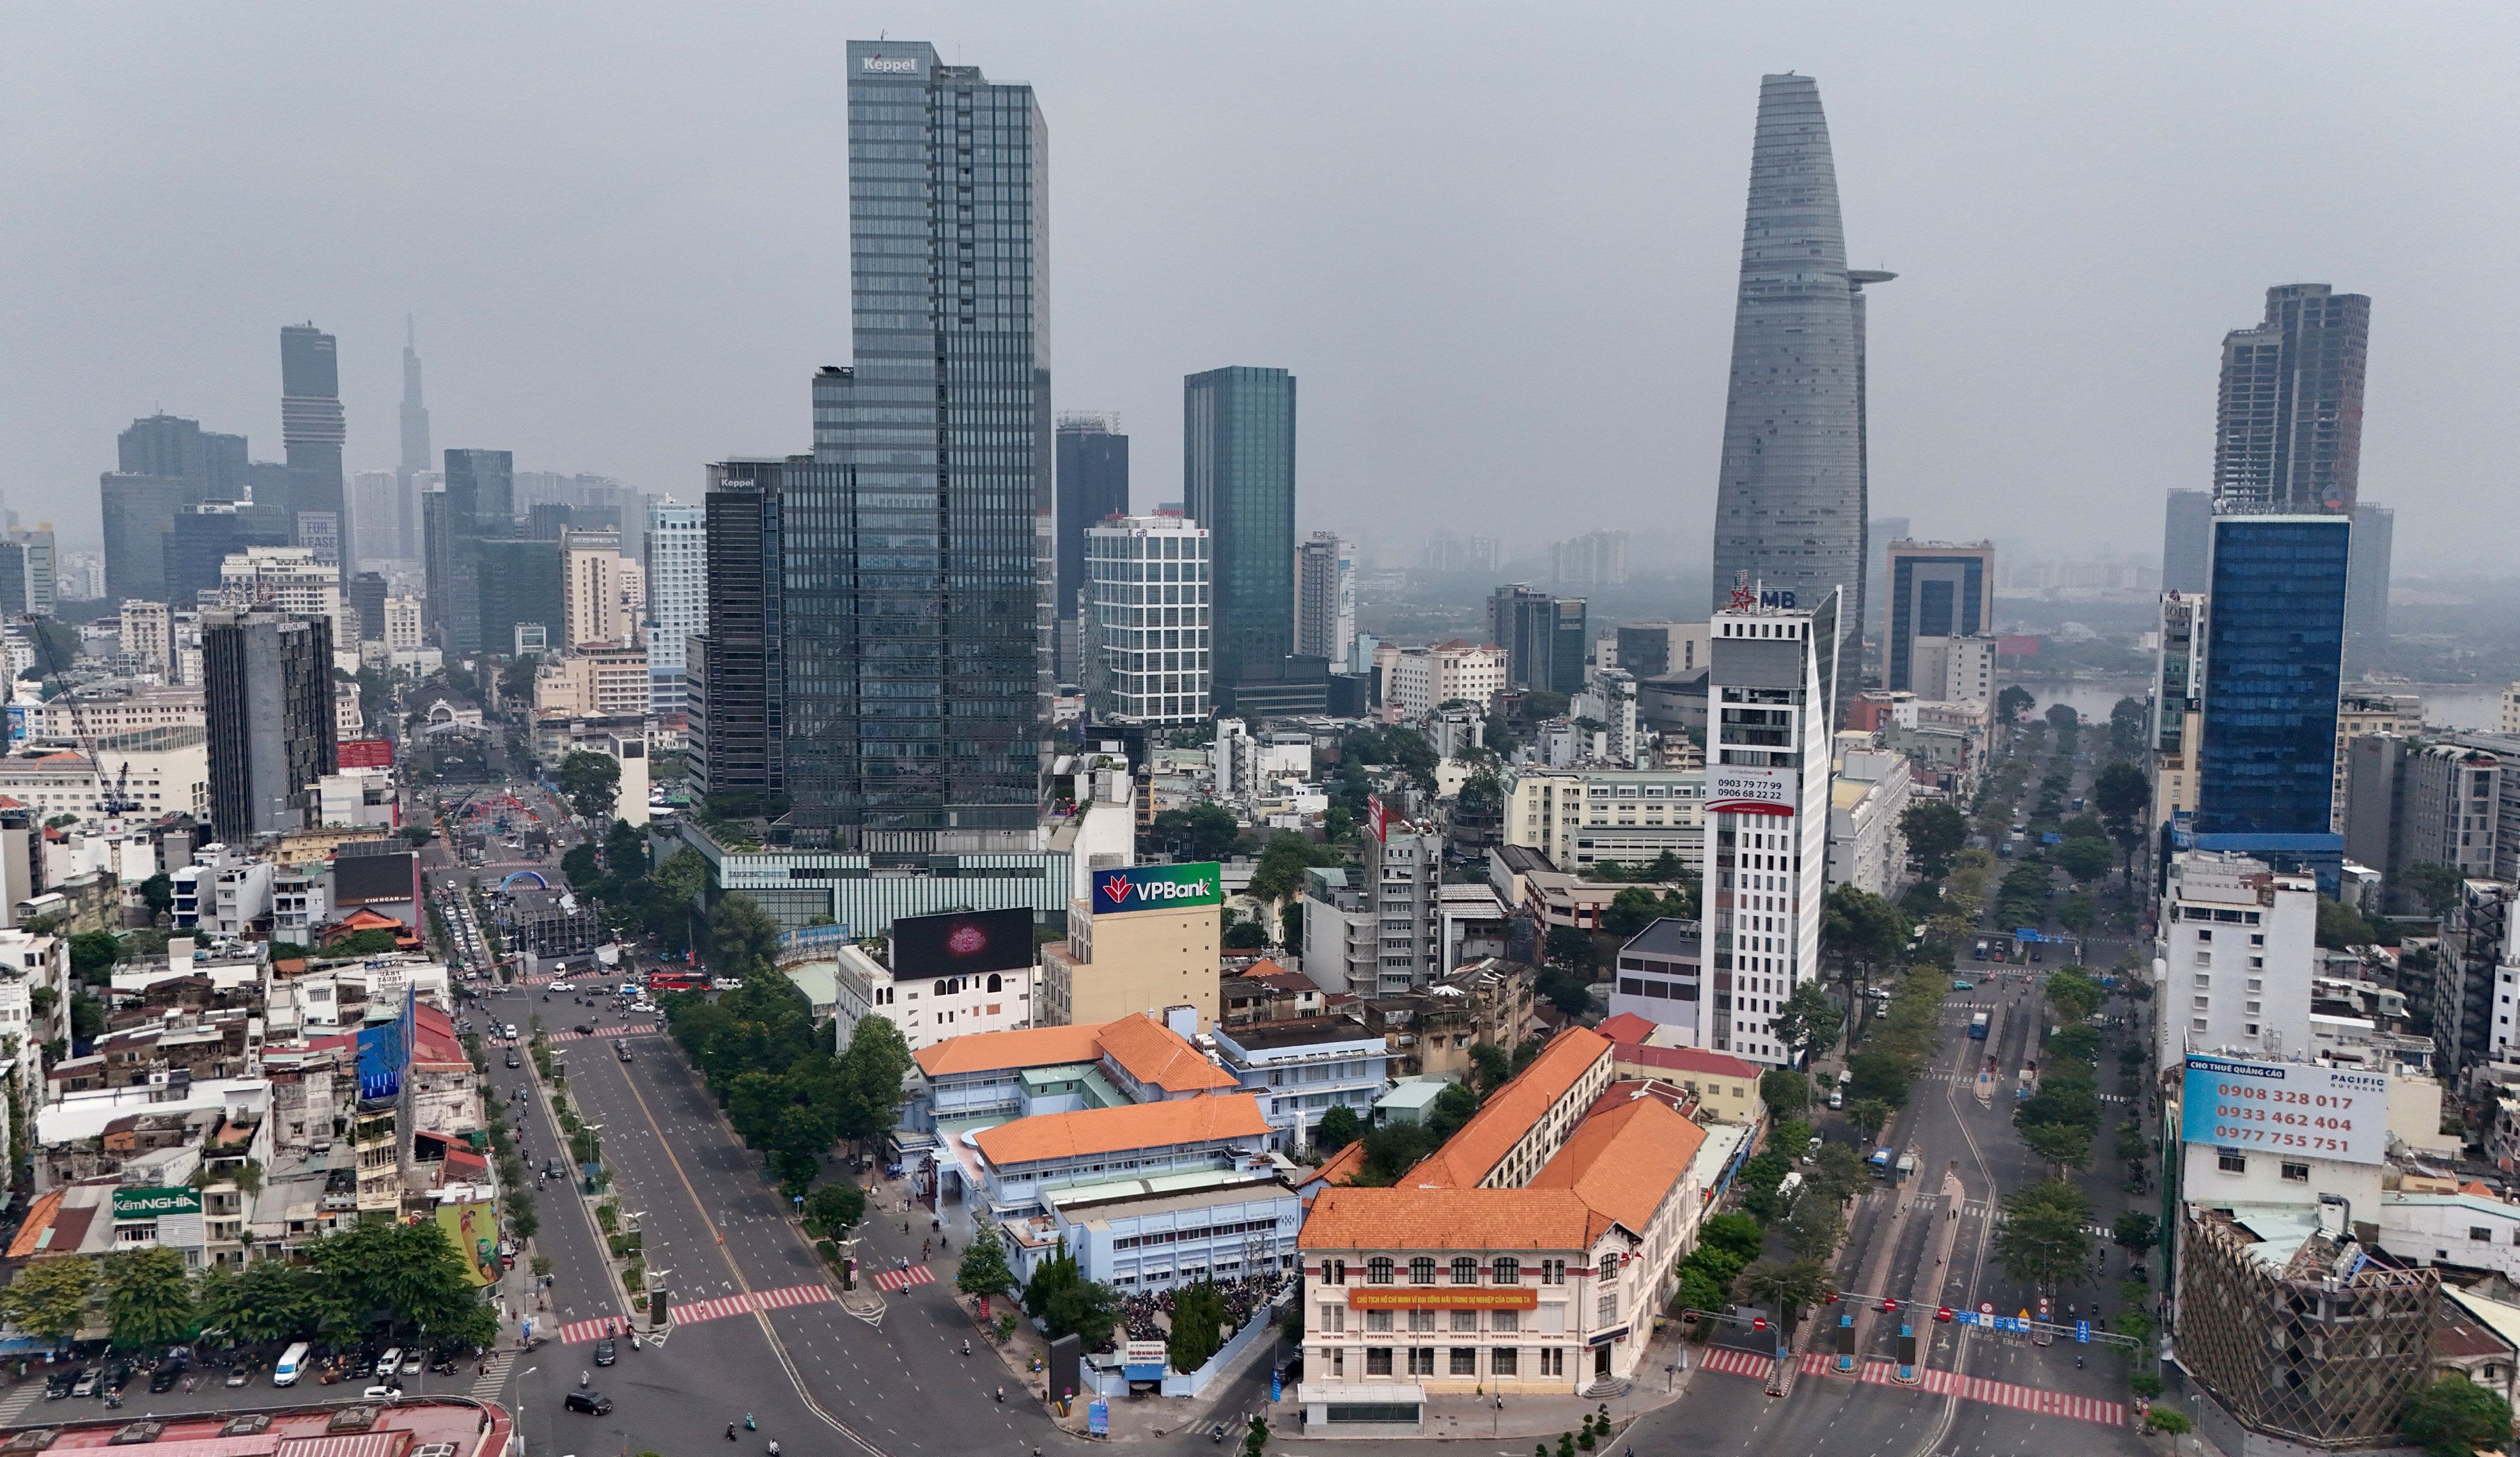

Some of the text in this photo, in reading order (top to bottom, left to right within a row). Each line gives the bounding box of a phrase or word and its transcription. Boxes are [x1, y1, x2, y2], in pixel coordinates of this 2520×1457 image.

[863, 58, 916, 73] Keppel
[721, 479, 754, 487] Keppel
[307, 522, 327, 534] FOR
[1136, 529, 1147, 537] citi
[300, 537, 335, 548] LEASE
[1760, 591, 1796, 609] MB
[277, 621, 310, 633] LIBERTY CENTRAL
[1718, 779, 1740, 787] 0903
[1718, 789, 1740, 797] 0906
[1743, 790, 1754, 798] 68
[1137, 878, 1210, 901] VPBank
[2190, 1061, 2208, 1070] CHO
[2209, 1063, 2231, 1072] THUÊ
[2265, 1067, 2283, 1078] CÁO
[2331, 1074, 2385, 1086] PACIFIC
[2330, 1083, 2384, 1093] OUTDOOR
[2218, 1084, 2353, 1109] 0908 328 017
[2217, 1105, 2351, 1131] 0933 462 404
[2215, 1126, 2348, 1152] 0977 755 751
[1357, 1294, 1367, 1303] CHỦ
[1368, 1296, 1379, 1304] TỊCH
[1380, 1294, 1388, 1303] HỒ
[1388, 1295, 1397, 1303] CHÍ
[1412, 1295, 1417, 1303] VĨ
[1417, 1296, 1426, 1304] ĐẠI
[1427, 1294, 1440, 1303] SỐNG
[1441, 1295, 1451, 1303] MÃI
[1476, 1295, 1495, 1304] NGHIỆP
[1495, 1294, 1505, 1303] CỦA
[1505, 1295, 1522, 1303] CHÚNG
[1971, 1331, 1993, 1341] BUS
[2002, 1338, 2025, 1348] BUS
